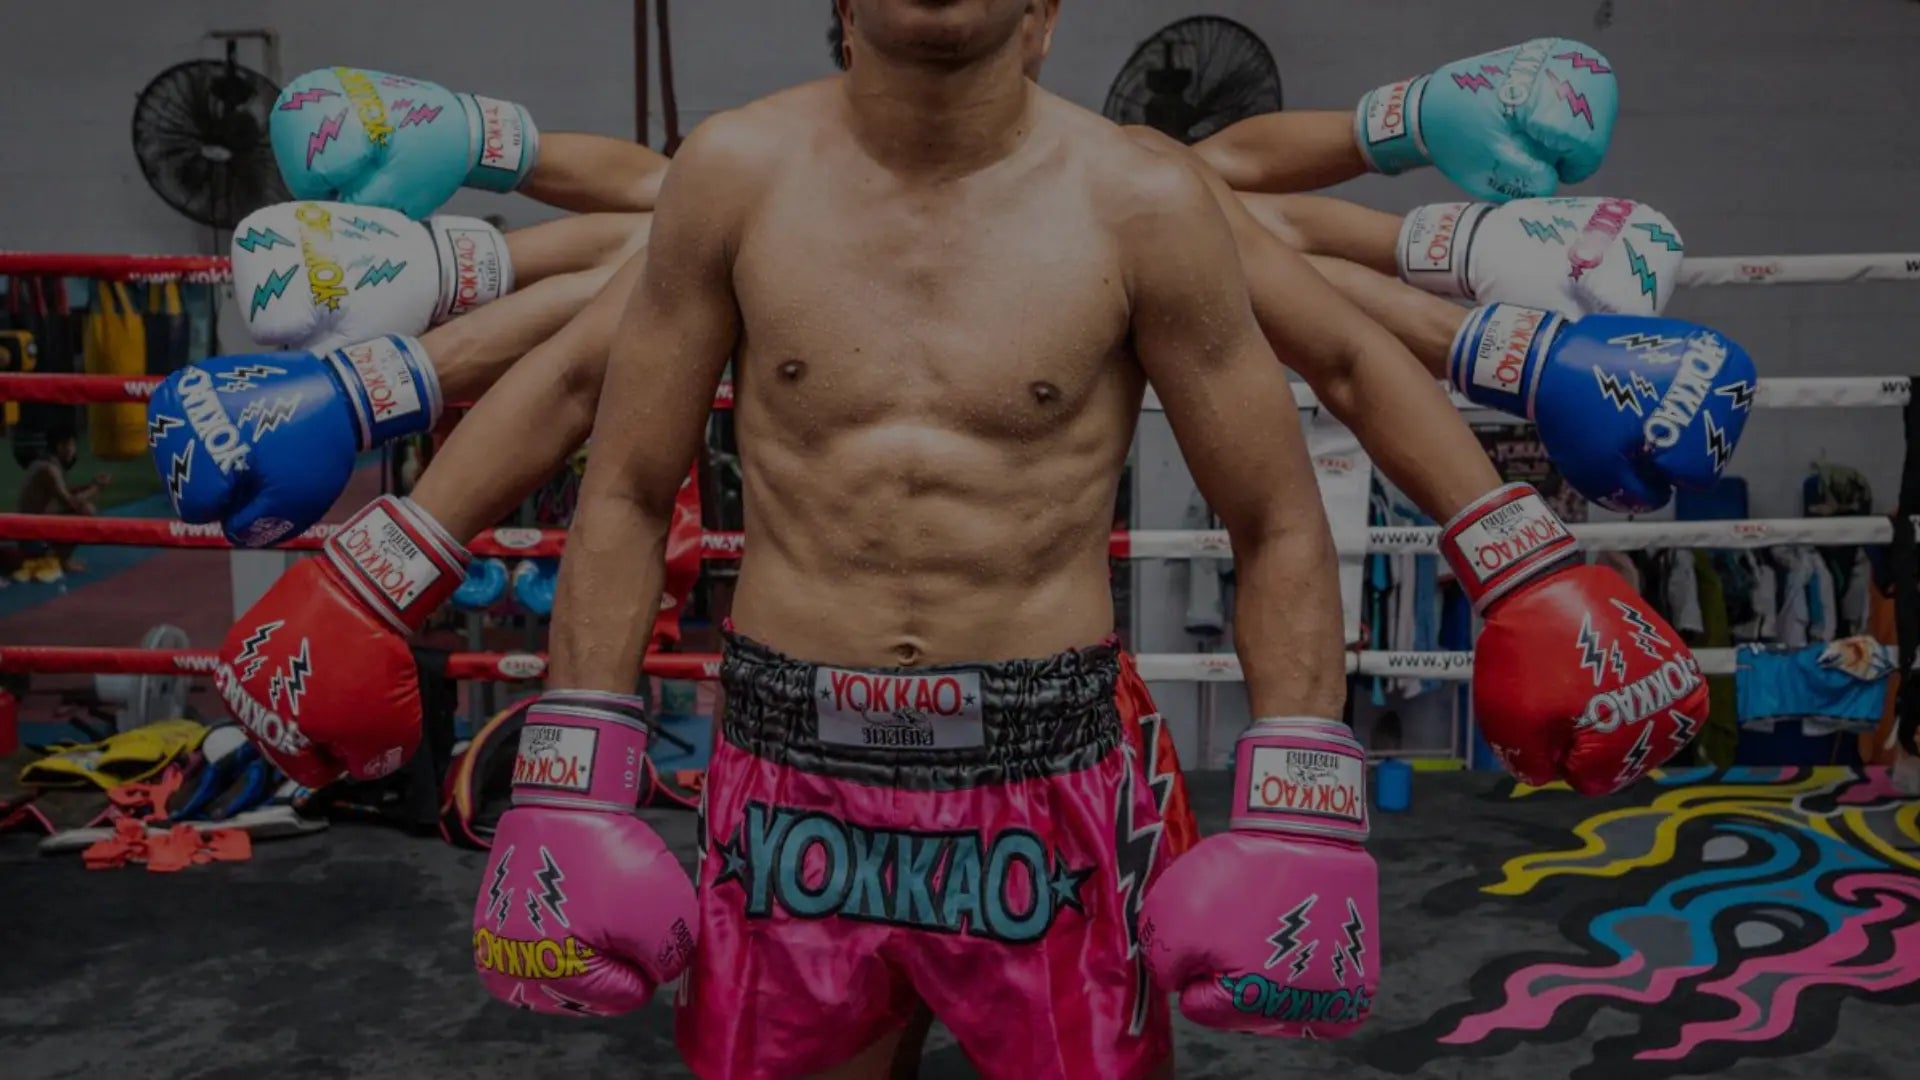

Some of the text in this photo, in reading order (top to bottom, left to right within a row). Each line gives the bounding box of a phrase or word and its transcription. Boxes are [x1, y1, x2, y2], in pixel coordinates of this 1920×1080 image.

[455, 236, 477, 309] YOKKAO
[1643, 336, 1728, 448] YOKKAO
[346, 527, 414, 601] YOKKAO
[1478, 514, 1557, 570] YOKKAO
[830, 671, 962, 717] YOKKAO
[1587, 652, 1700, 735] YOKKAO
[1261, 776, 1357, 815] YOKKAO
[746, 800, 1055, 944] YOKKAO
[473, 927, 588, 979] YOKKAO
[1232, 972, 1367, 1022] YOKKAO
